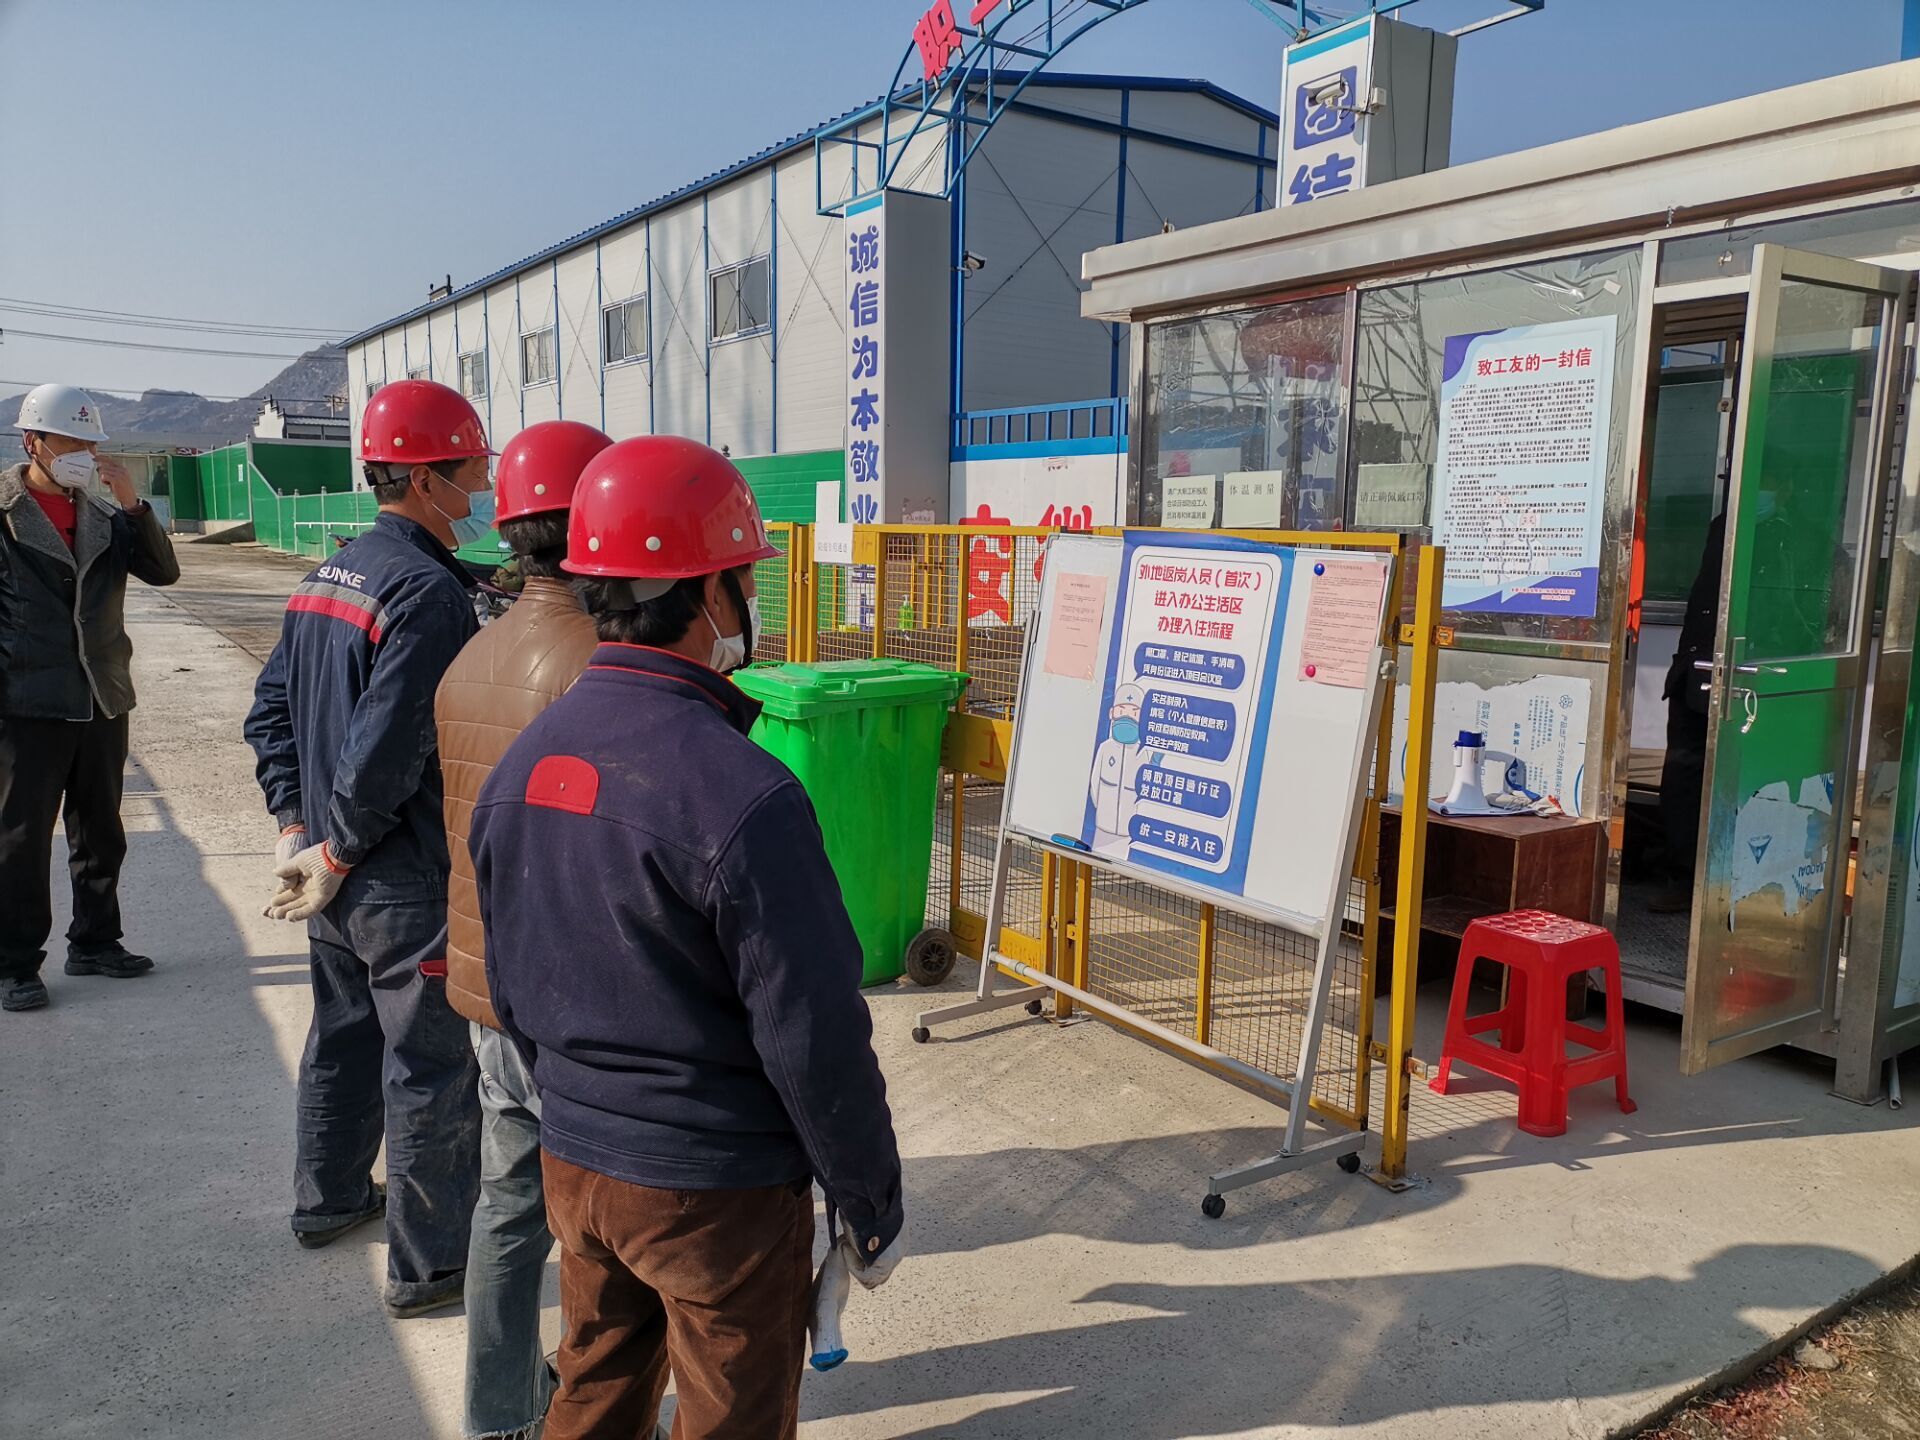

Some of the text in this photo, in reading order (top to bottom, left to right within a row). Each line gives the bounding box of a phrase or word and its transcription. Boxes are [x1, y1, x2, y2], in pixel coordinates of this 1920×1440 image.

[1476, 347, 1592, 377] 致工友的一封信
[1229, 483, 1275, 496] 体温测量
[317, 566, 366, 589] SUNKE
[1138, 563, 1262, 591] 外地返岗人员（首次）
[1154, 590, 1244, 614] 进入办公生活区
[1157, 616, 1234, 640] 办理入住流程
[1139, 783, 1183, 805] 发放口罩
[1142, 769, 1220, 799] 领取项目通行证
[1139, 822, 1217, 856] 统一安排入住
